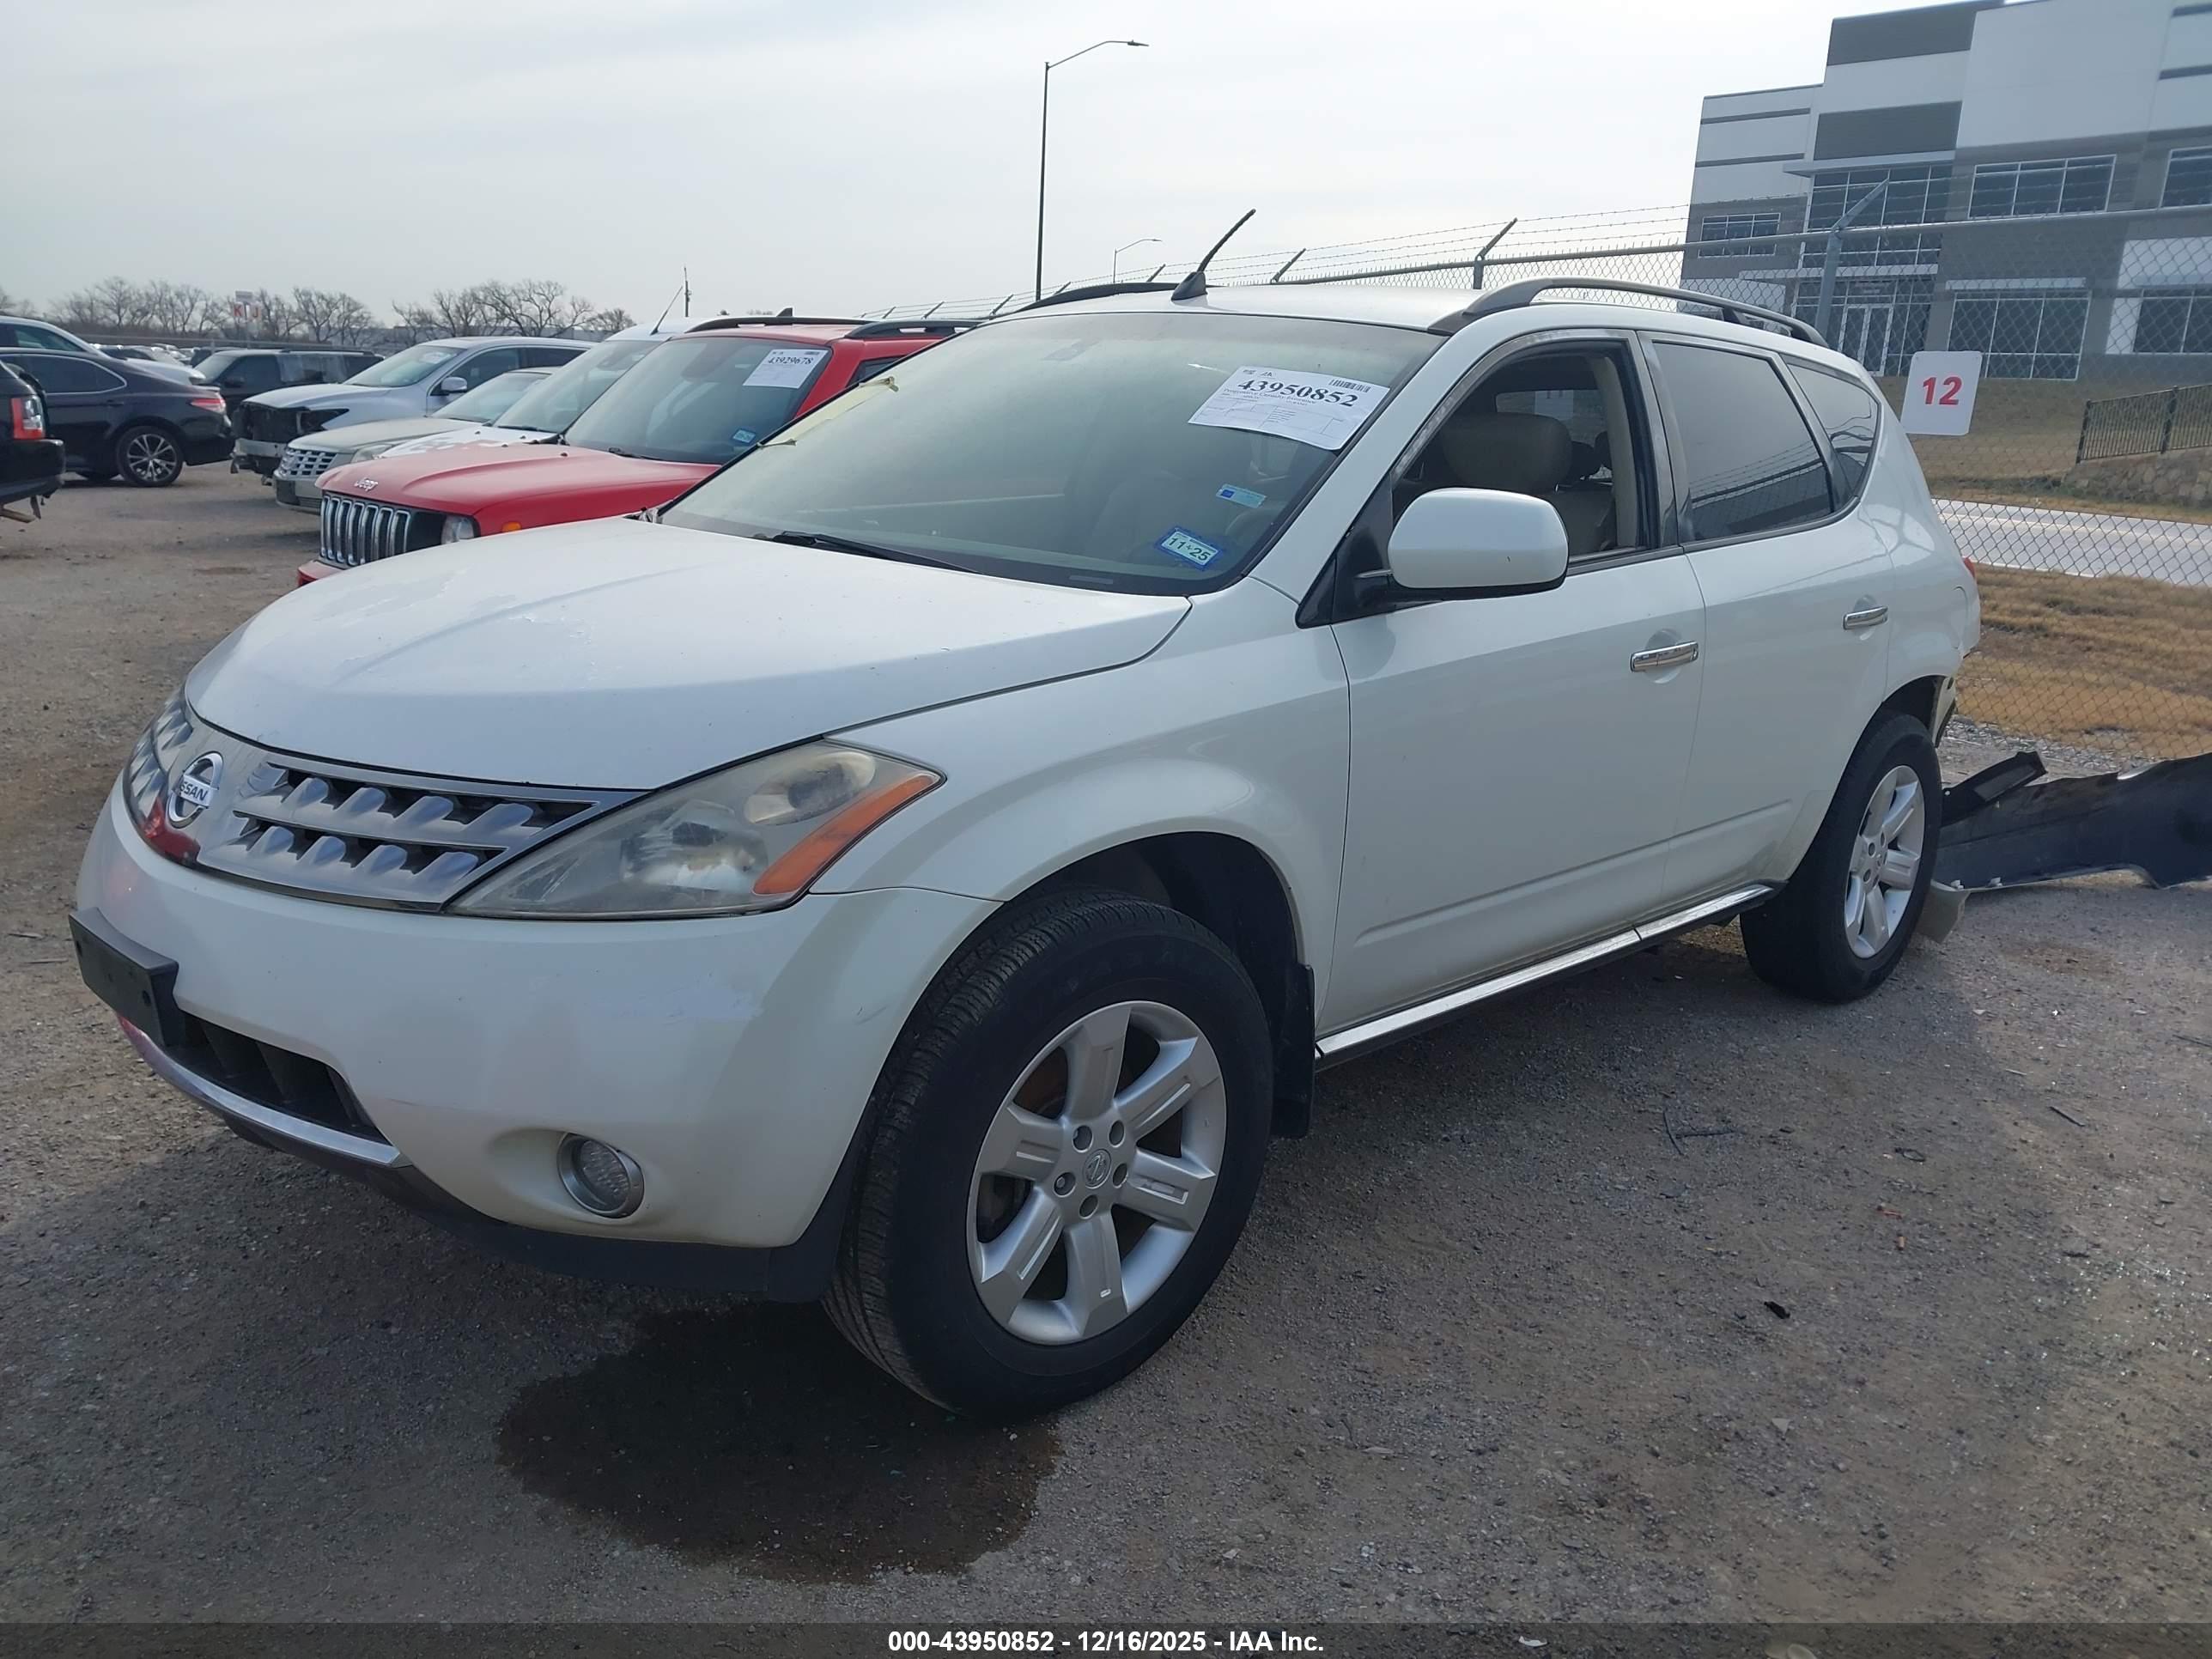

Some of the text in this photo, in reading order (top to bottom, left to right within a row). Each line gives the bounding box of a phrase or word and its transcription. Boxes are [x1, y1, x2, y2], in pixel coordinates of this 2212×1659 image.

[1237, 379, 1359, 407] 43950852
[1923, 375, 1963, 405] 12
[354, 479, 379, 492] Jeep
